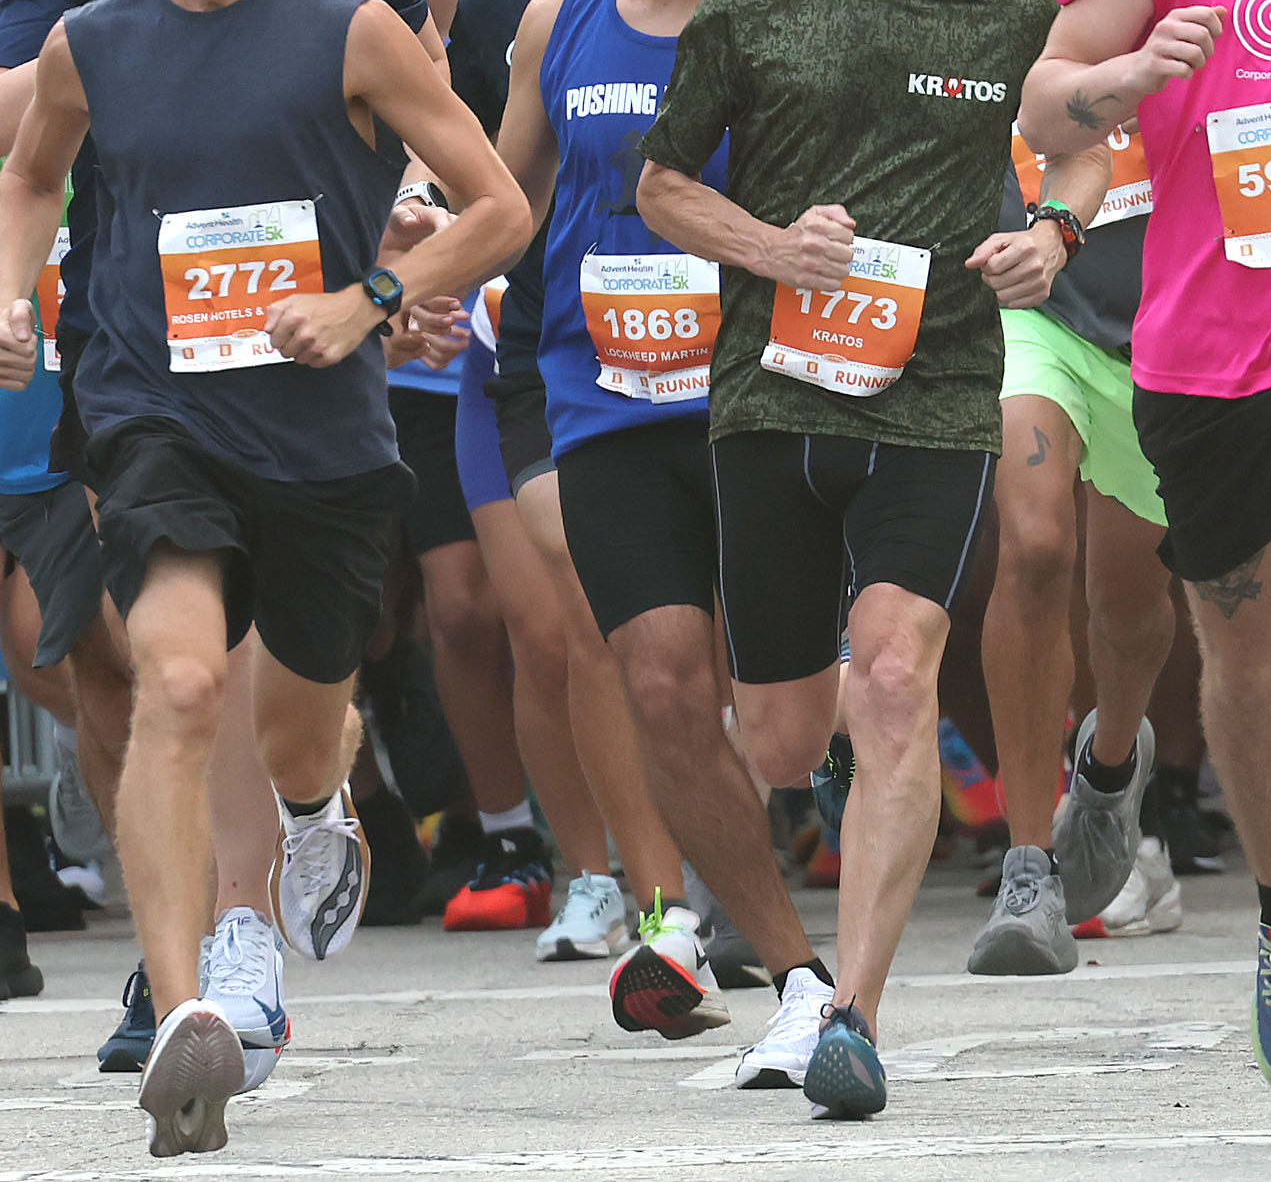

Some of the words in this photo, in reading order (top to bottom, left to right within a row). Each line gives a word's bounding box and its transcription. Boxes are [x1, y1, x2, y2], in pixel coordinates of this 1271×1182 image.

[566, 82, 658, 121] PUSHING
[908, 73, 1007, 103] KRATOS
[1102, 190, 1153, 214] RUNNE
[184, 259, 297, 300] 2772
[172, 312, 209, 325] ROSEN
[211, 307, 253, 321] HOTELS
[255, 307, 265, 316] &
[603, 308, 700, 340] 1868
[795, 288, 898, 331] 1773
[812, 329, 864, 348] KRATOS
[604, 347, 657, 362] LOCKHEED
[661, 348, 708, 362] MARTIN
